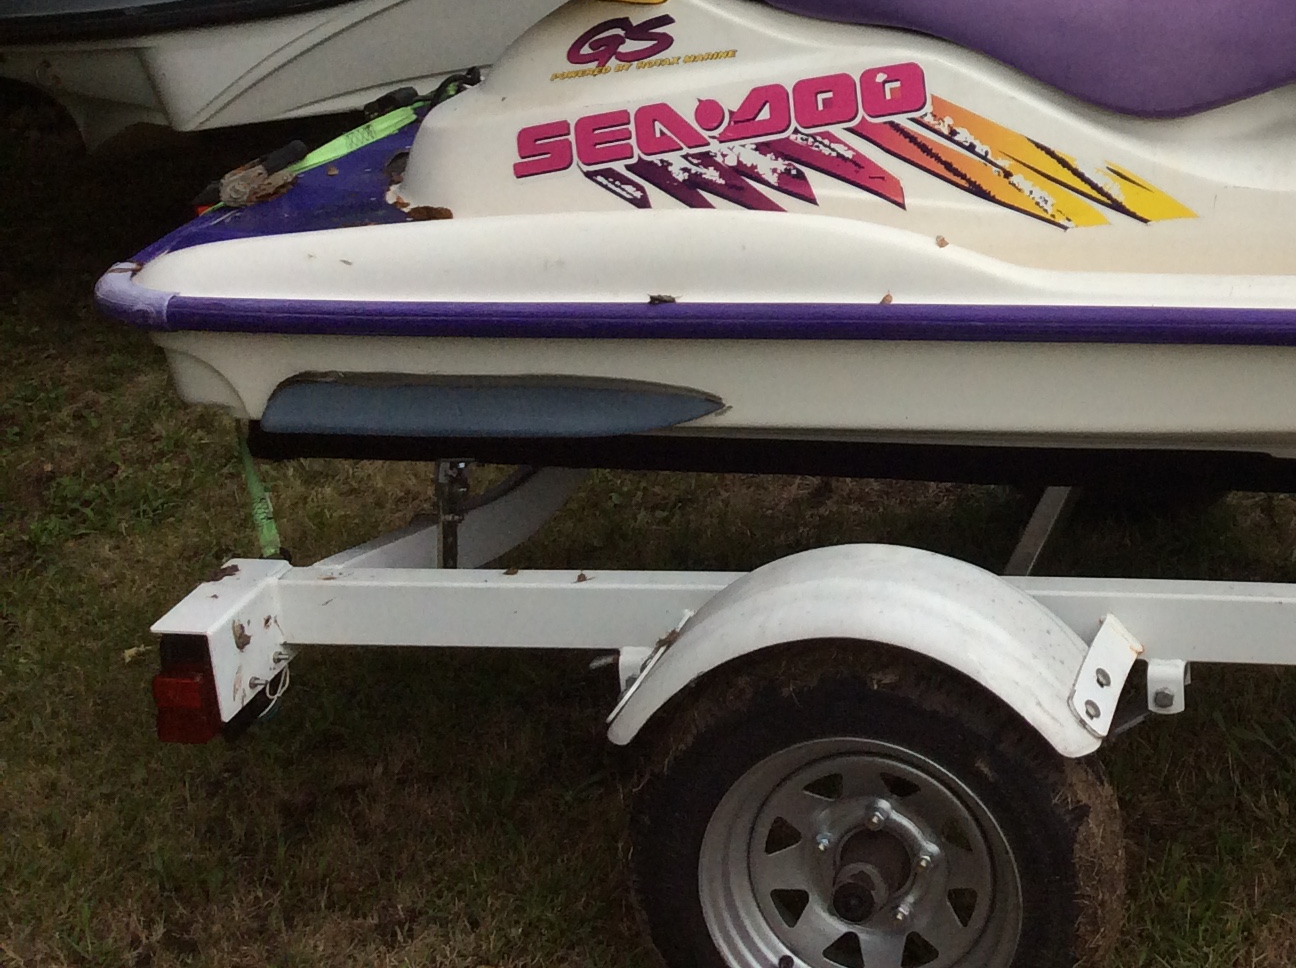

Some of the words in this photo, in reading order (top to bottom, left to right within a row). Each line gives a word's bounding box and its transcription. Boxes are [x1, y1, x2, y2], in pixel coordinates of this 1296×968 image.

[566, 13, 677, 69] GS
[550, 65, 613, 82] POWERED
[614, 62, 632, 74] BY
[635, 55, 683, 71] ROTAX
[682, 48, 739, 65] MARINE
